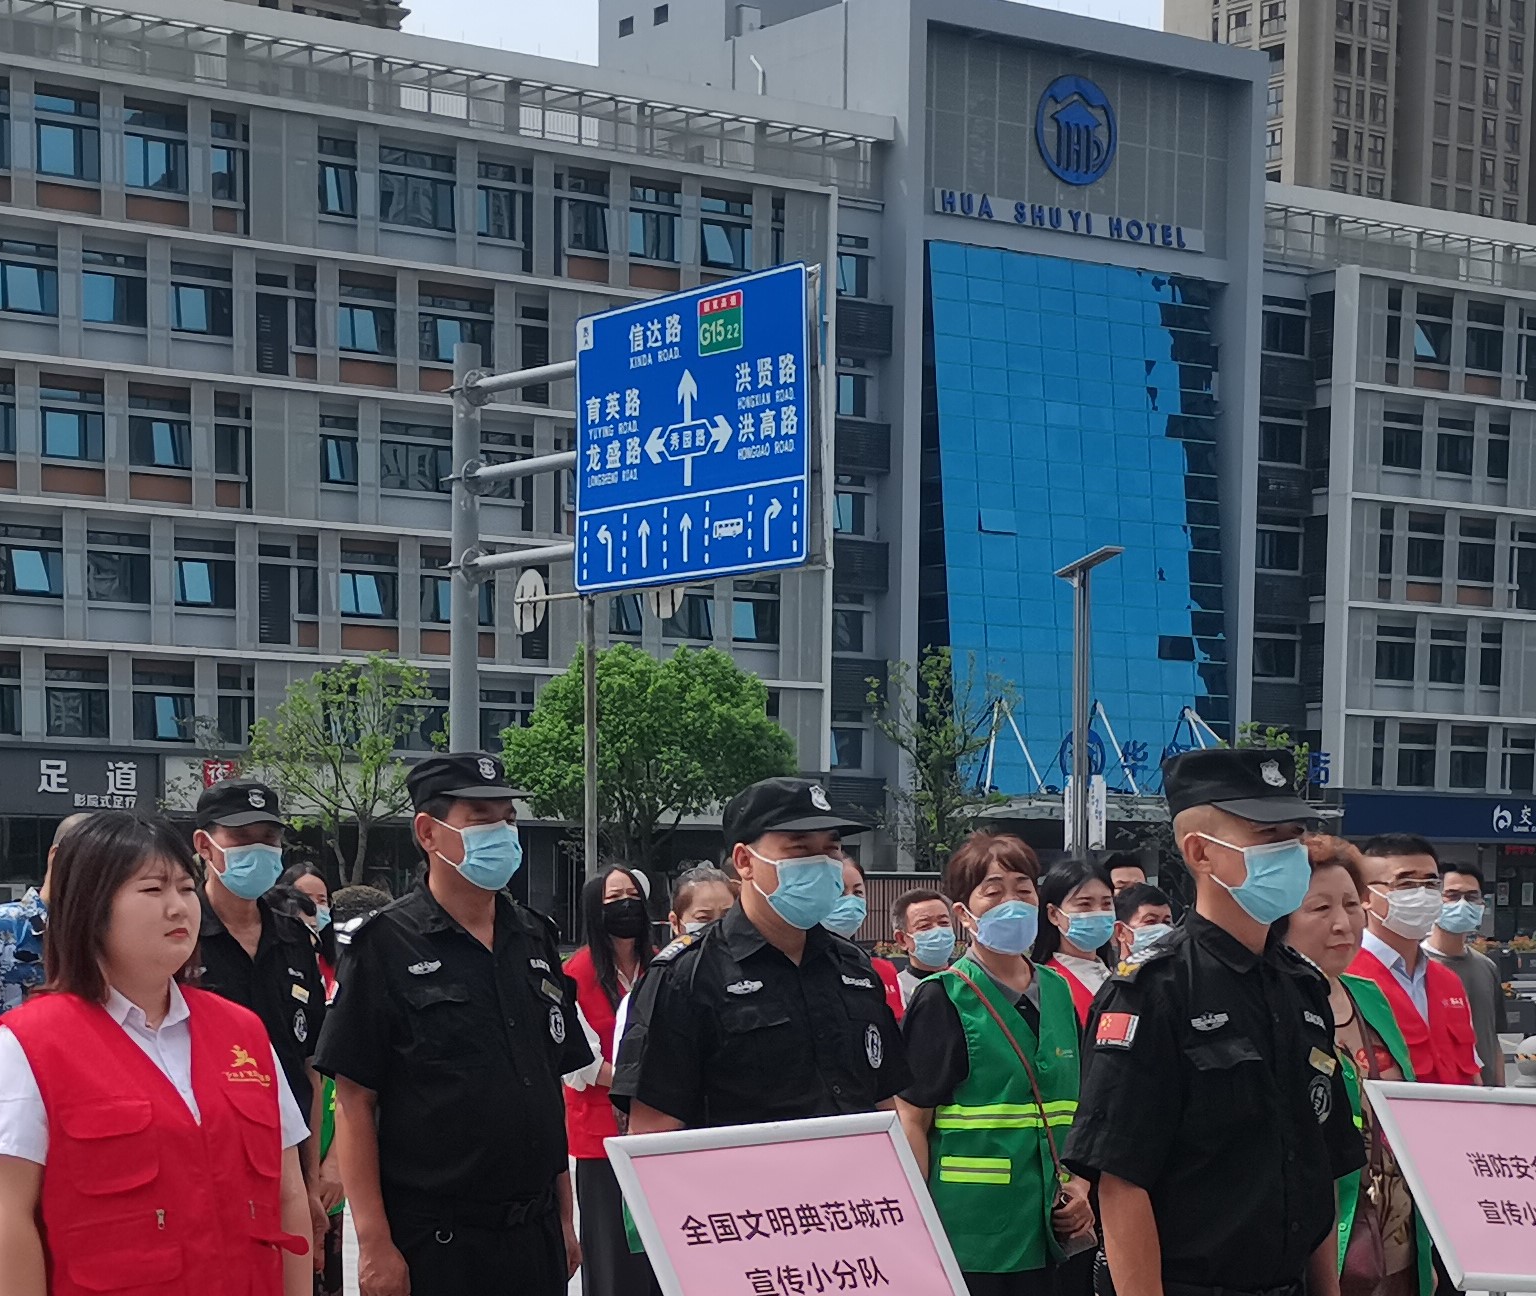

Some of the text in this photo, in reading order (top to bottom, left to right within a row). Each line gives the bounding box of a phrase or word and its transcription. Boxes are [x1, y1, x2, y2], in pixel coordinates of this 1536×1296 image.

[941, 189, 1187, 249] HUA SHUYI HOTEL
[629, 313, 682, 353] 信达路
[735, 353, 797, 393] 洪贤路
[585, 387, 641, 425] 育英路
[737, 405, 799, 443] 洪高路
[585, 436, 642, 473] 龙盛路
[679, 1196, 905, 1247] 全国文明典范城市
